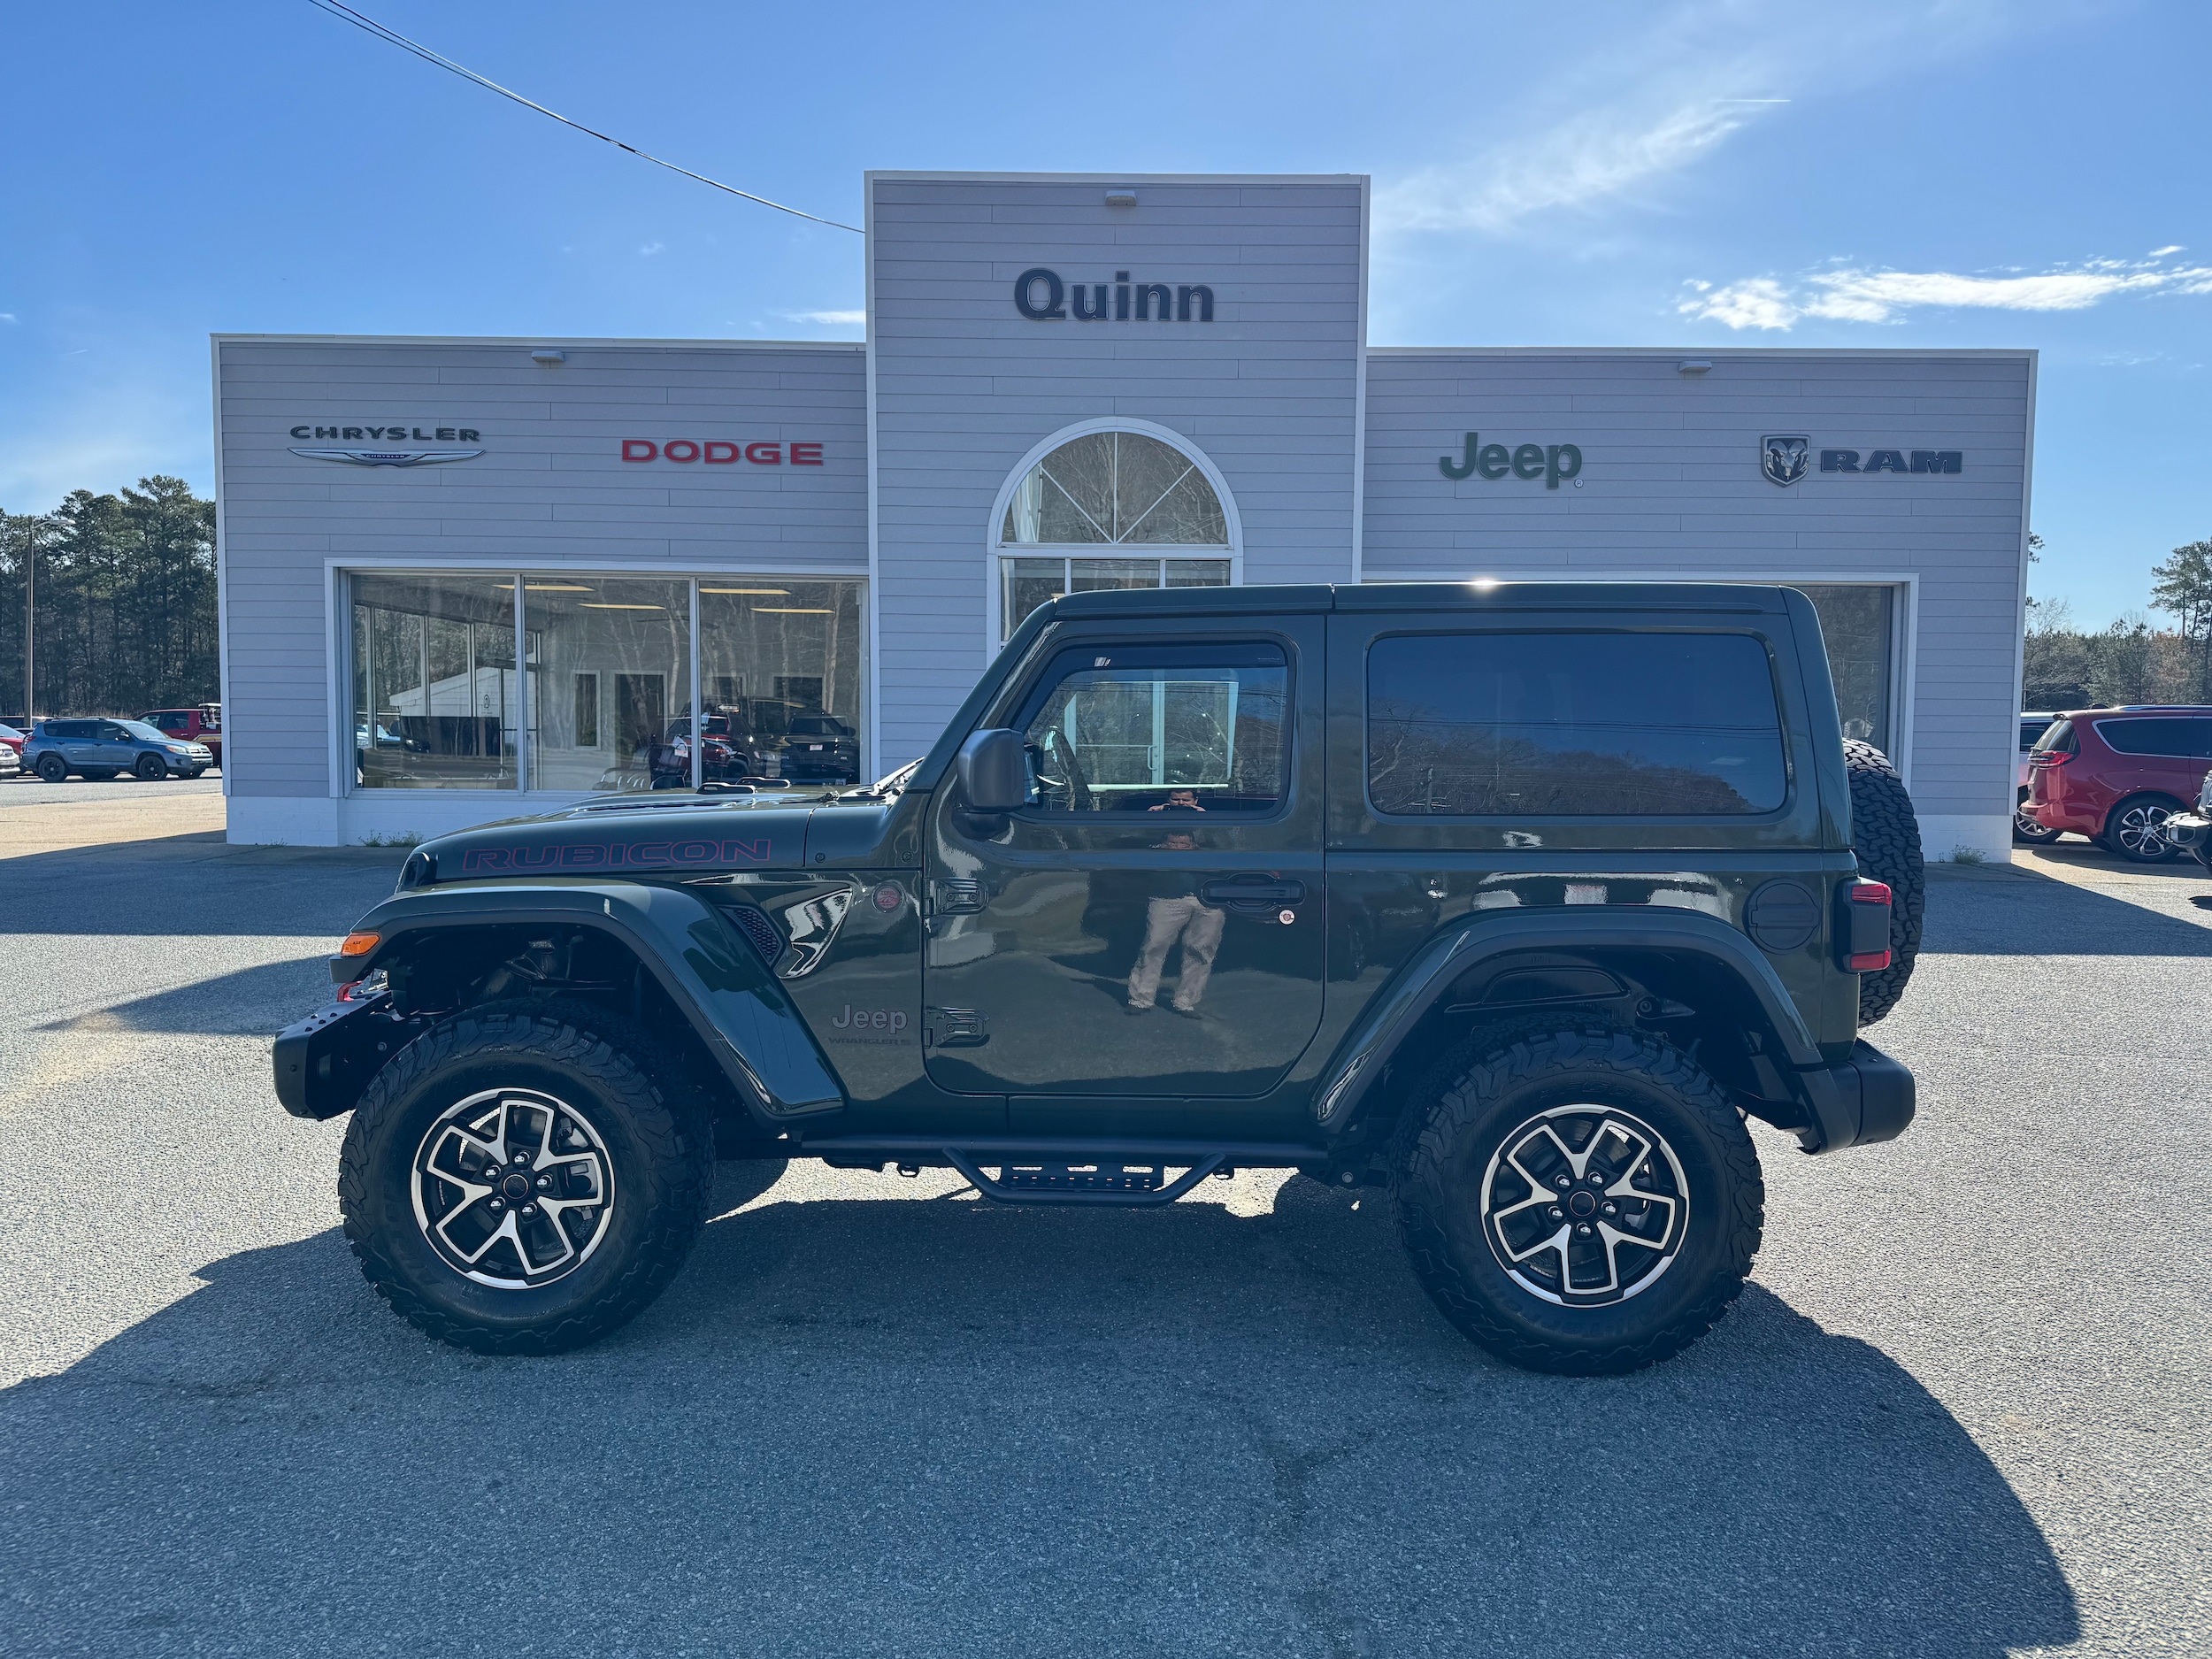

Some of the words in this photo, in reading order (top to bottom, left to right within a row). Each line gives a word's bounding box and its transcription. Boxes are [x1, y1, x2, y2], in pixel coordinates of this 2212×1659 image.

[1015, 267, 1214, 321] Quinn
[289, 426, 481, 442] CHRYSLER
[621, 439, 825, 466] DODGE
[1439, 432, 1582, 489] Jeep
[1819, 449, 1963, 474] RAM
[463, 839, 772, 871] RUBICON
[831, 1003, 909, 1035] Jeep
